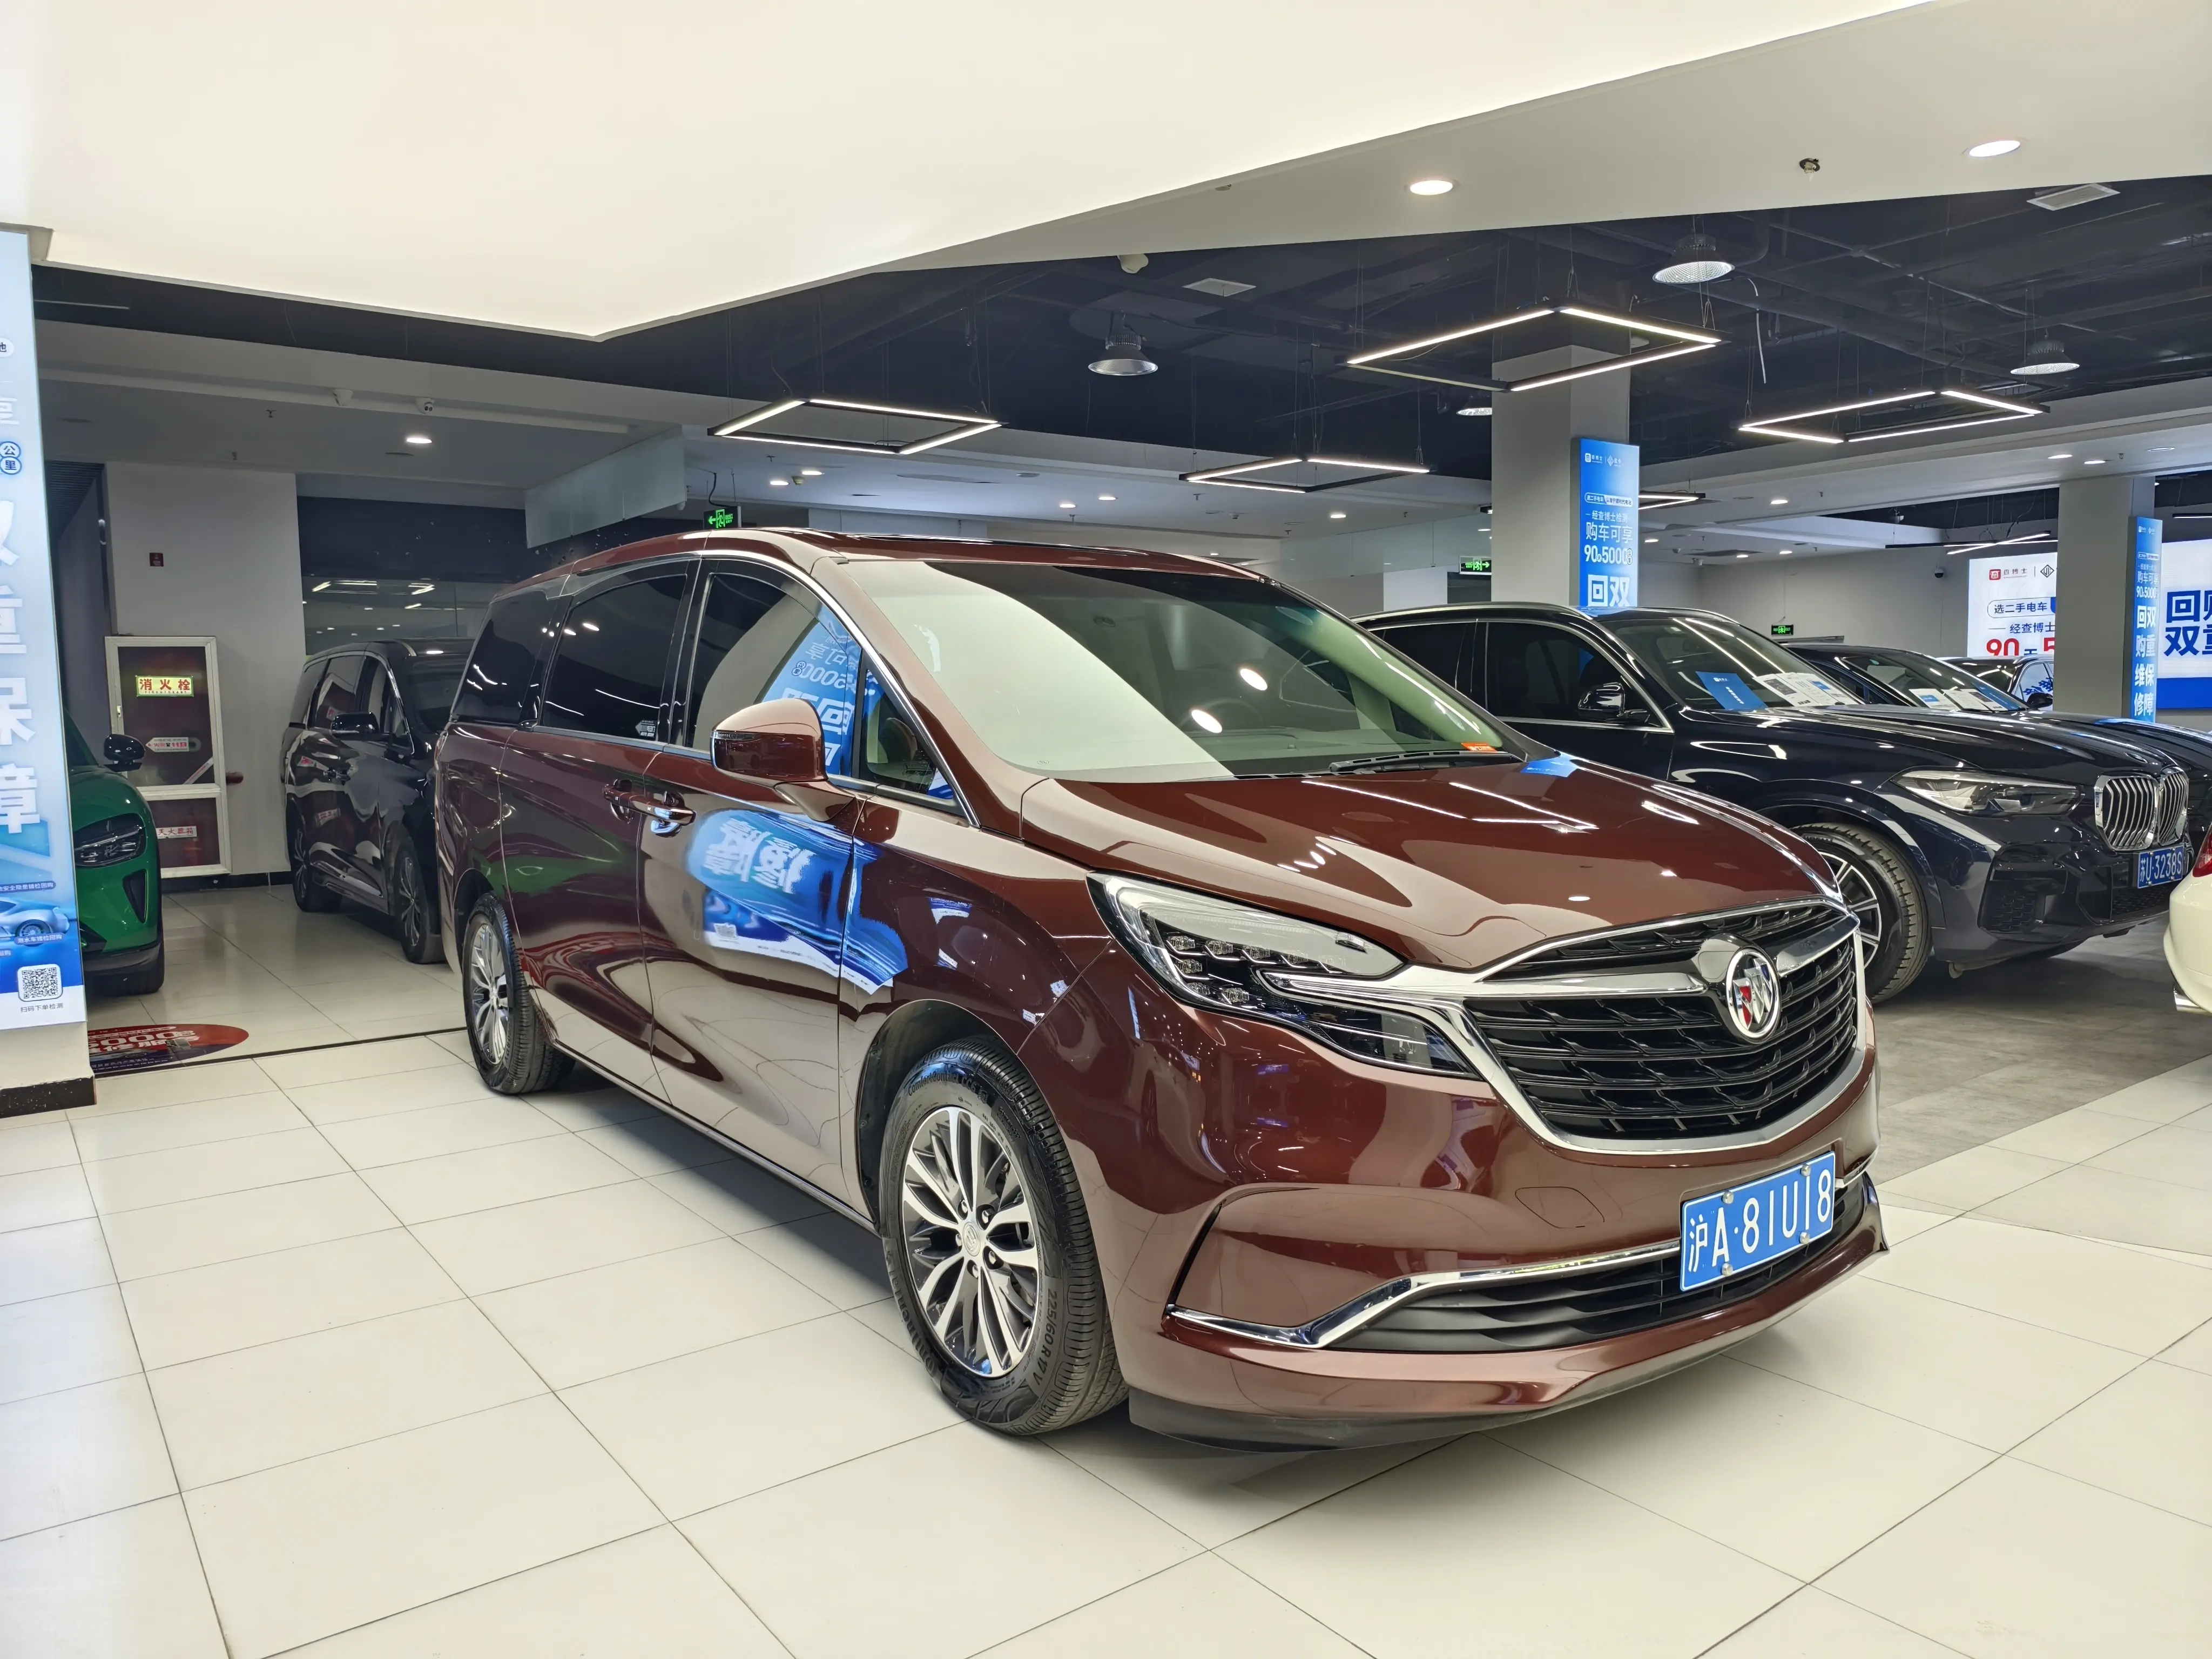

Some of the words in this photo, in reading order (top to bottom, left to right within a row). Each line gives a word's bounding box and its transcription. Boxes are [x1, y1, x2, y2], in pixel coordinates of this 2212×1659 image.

[3, 444, 17, 471] 公里
[1591, 510, 1628, 523] 经查博士检测
[1586, 522, 1633, 543] 购车可享
[1994, 602, 2047, 614] 选二手电车
[2009, 621, 2055, 634] 经查博士
[139, 678, 191, 691] 消火栓
[157, 827, 193, 835] 灭火器箱
[21, 1002, 63, 1013] 扫码下单检测
[1688, 1169, 1831, 1273] 沪A·81U18
[1045, 1288, 1057, 1345] 225/60
[1041, 1346, 1051, 1357] R
[1037, 1357, 1048, 1374] 17
[1033, 1372, 1043, 1386] V
